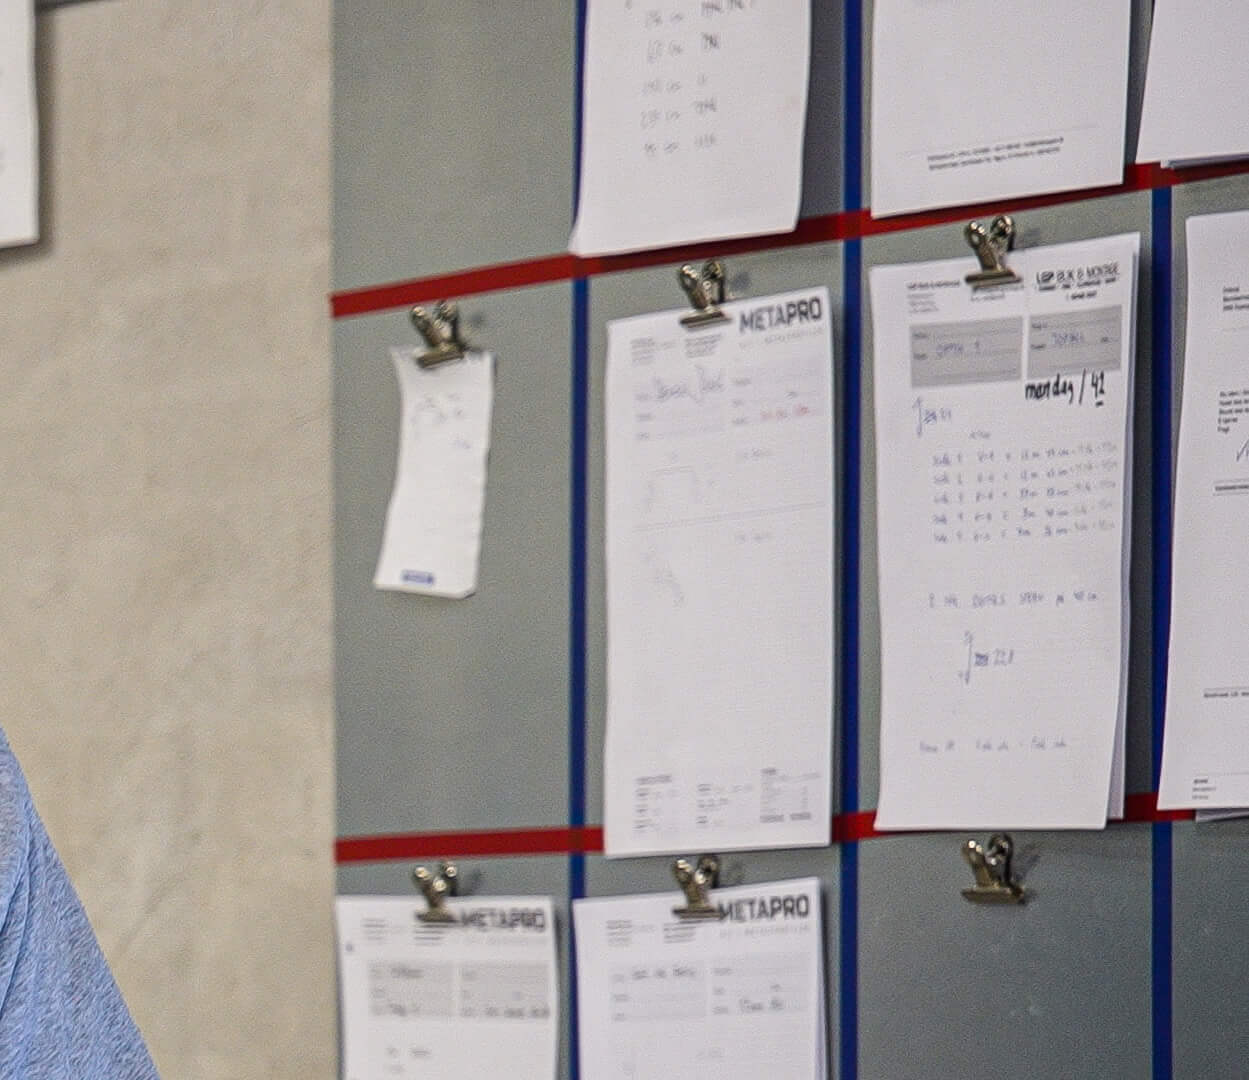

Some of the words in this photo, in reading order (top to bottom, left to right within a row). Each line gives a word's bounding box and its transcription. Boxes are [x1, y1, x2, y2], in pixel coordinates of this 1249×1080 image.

[738, 296, 822, 334] METAPRO
[1024, 372, 1074, 405] monday
[718, 894, 810, 923] METAPRO
